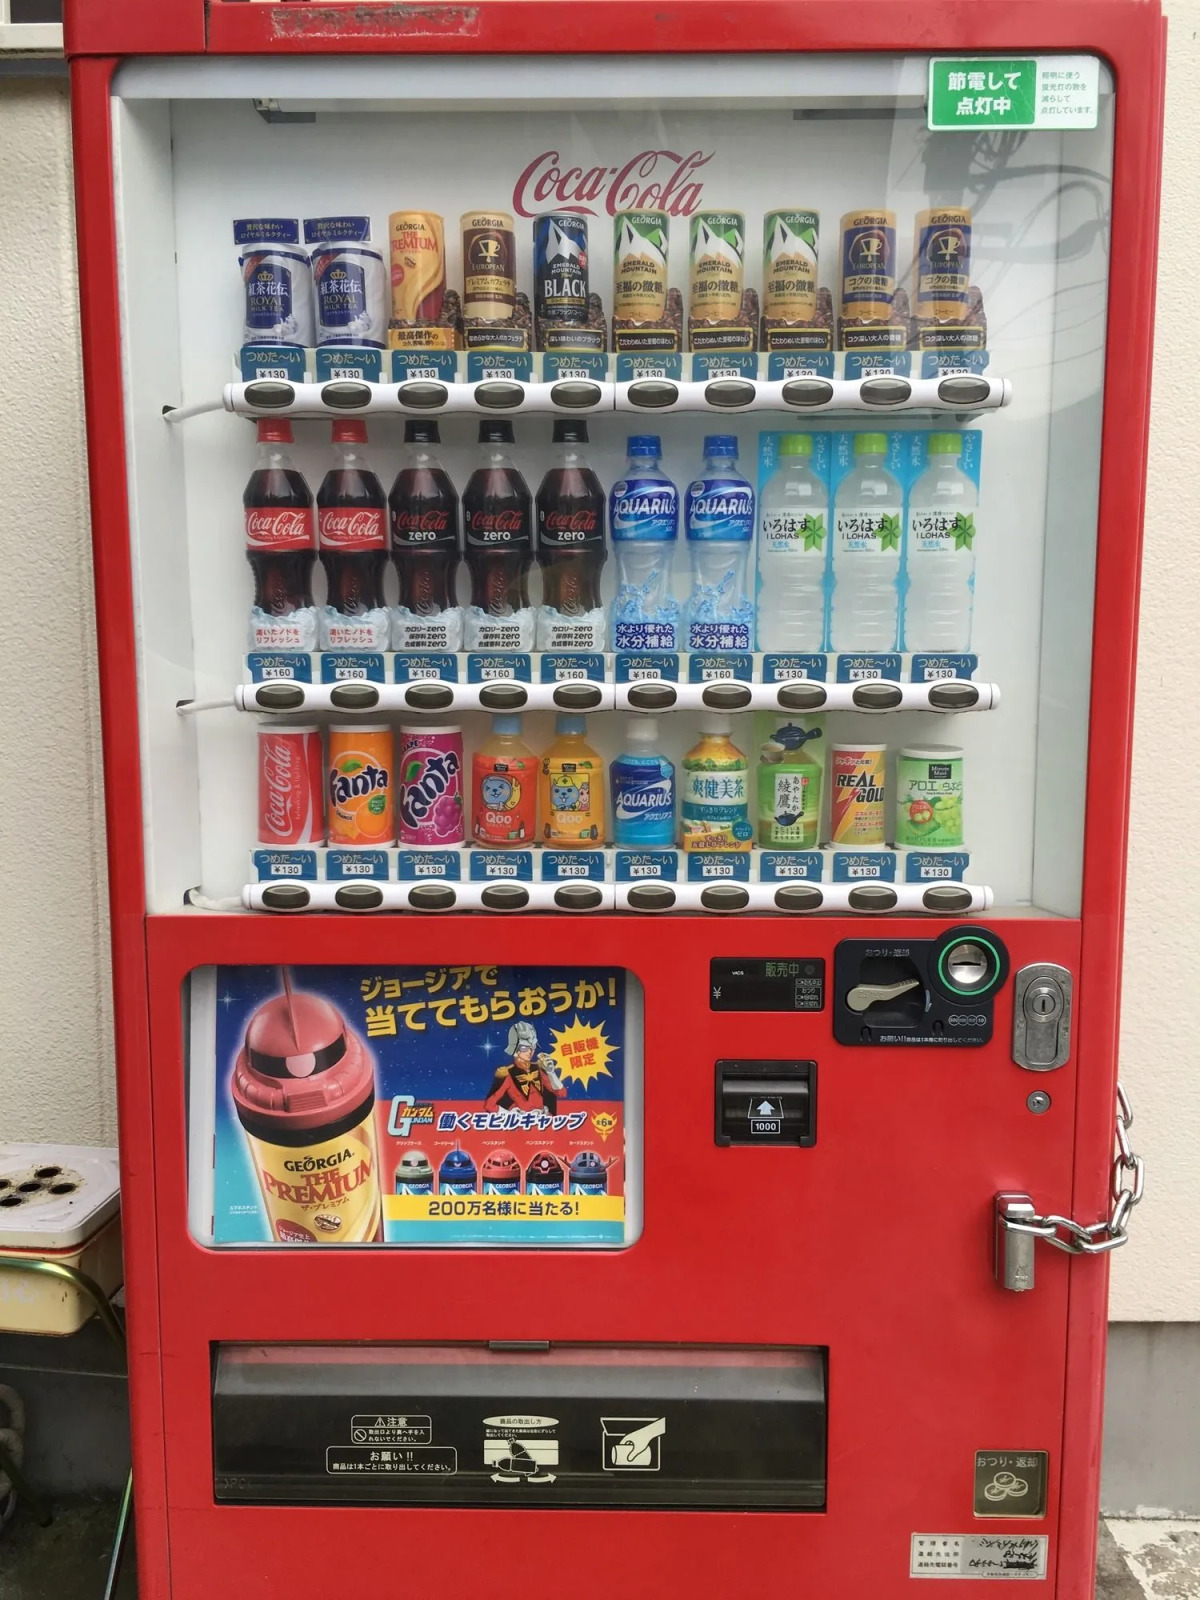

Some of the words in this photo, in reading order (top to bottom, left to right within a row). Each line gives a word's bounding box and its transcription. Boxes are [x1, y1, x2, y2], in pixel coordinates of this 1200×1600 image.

[1042, 72, 1080, 80] 照明に使う
[947, 71, 1021, 92] 節電して
[1041, 83, 1087, 91] 蛍光灯の数を
[1041, 95, 1071, 103] 減らして
[956, 97, 1011, 115] 点灯中
[512, 150, 716, 218] Coca-Cola
[472, 217, 504, 228] GEORGIA
[631, 216, 662, 226] GEORGIA
[707, 215, 738, 226] GEORGIA
[785, 214, 816, 225] GEORGIA
[853, 215, 887, 226] GEORGIA
[931, 213, 966, 223] GEORGIA
[395, 222, 426, 231] GEORGIA
[558, 218, 585, 230] GEORGIA
[401, 231, 418, 240] THE
[472, 263, 505, 272] EUROPEAN
[552, 262, 581, 271] EMERALD
[248, 281, 289, 296] 紅茶花伝
[320, 280, 362, 296] 紅茶花伝
[544, 279, 586, 298] BLACK
[615, 280, 665, 295] 至福の微糖
[692, 280, 740, 293] 至福の微糖
[767, 280, 816, 293] 至福の微糖
[250, 296, 284, 306] ROYAL
[323, 294, 357, 304] ROYAL
[397, 330, 439, 340] 最高傑作の
[259, 370, 286, 378] ¥130
[334, 370, 360, 378] ¥130
[410, 370, 436, 378] ¥130
[486, 370, 512, 378] ¥130
[561, 370, 586, 378] ¥130
[636, 370, 662, 378] ¥130
[711, 369, 737, 377] ¥130
[763, 435, 774, 467] 天然水
[815, 435, 827, 470] やさしい
[613, 498, 676, 515] AQUARIUS
[690, 498, 753, 515] AQUARIUS
[248, 511, 306, 536] Coca-Cola
[323, 511, 381, 536] Coca-Cola
[397, 510, 449, 530] Coca-Cola
[471, 510, 523, 530] Coca-Cola
[545, 510, 597, 530] Coca-Cola
[762, 518, 811, 532] いろはす
[837, 518, 888, 532] いろはす
[911, 517, 962, 531] いろはす
[408, 531, 436, 541] zero
[483, 531, 511, 541] zero
[557, 531, 585, 541] zero
[770, 532, 800, 540] LOHAS
[846, 532, 877, 540] LOHAS
[921, 531, 951, 539] LOHAS
[255, 628, 301, 636] 渇いたノドを
[329, 628, 374, 636] 渇いたノドを
[617, 624, 673, 634] 水より優れた
[691, 624, 748, 634] 水より優れた
[256, 636, 301, 644] リフレッシュ
[329, 636, 374, 644] リフレッシュ
[617, 636, 673, 648] 水分補給
[691, 636, 748, 648] 水分補給
[265, 669, 291, 677] ¥160
[339, 669, 364, 678] ¥160
[412, 669, 437, 678] ¥160
[484, 669, 510, 678] ¥160
[558, 670, 584, 679] ¥160
[633, 671, 659, 679] ¥160
[705, 670, 731, 679] ¥160
[777, 670, 803, 678] ¥130
[852, 670, 878, 679] ¥130
[927, 670, 953, 678] ¥130
[837, 770, 877, 787] REAL
[263, 736, 293, 837] Coca-Cola
[329, 764, 389, 807] Fanta
[400, 750, 460, 829] Fanta
[692, 777, 744, 799] 爽健美茶
[777, 778, 792, 809] 綾鷹
[792, 776, 800, 812] あやたか
[616, 791, 672, 807] AQUARIUS
[485, 811, 513, 825] Qoo
[556, 813, 583, 824] Qoo
[643, 811, 672, 820] アクエリアス
[274, 866, 299, 874] ¥130
[418, 866, 443, 874] ¥130
[489, 867, 515, 875] ¥130
[560, 867, 586, 875] ¥130
[633, 867, 658, 875] ¥130
[705, 867, 731, 875] ¥130
[779, 867, 804, 875] ¥130
[852, 868, 877, 876] ¥130
[924, 868, 949, 876] ¥130
[865, 948, 910, 957] おつり・返却
[765, 962, 800, 977] 販売中
[359, 965, 499, 1002] ジョージアで
[713, 986, 722, 999] ¥
[365, 977, 617, 1038] 当ててもらおうか!
[560, 1036, 600, 1057] 自販機
[569, 1053, 596, 1070] 限定
[402, 1106, 434, 1118] ガンダム
[438, 1111, 587, 1133] 働くモビルキャップ
[596, 1118, 613, 1126] 全6種
[755, 1122, 777, 1131] 1000
[283, 1149, 355, 1172] GEORGIA
[262, 1158, 374, 1205] PREMIUM
[301, 1167, 340, 1187] THE
[301, 1197, 350, 1212] ザ・プレミアム
[428, 1200, 580, 1216] 200万名様に当たる!
[387, 1417, 408, 1427] 注意
[332, 1463, 452, 1471] 商品は1本ごとに取り出してください。
[977, 1456, 1038, 1468] おつり・返却
[917, 1561, 959, 1569] 連絡先電話番号
